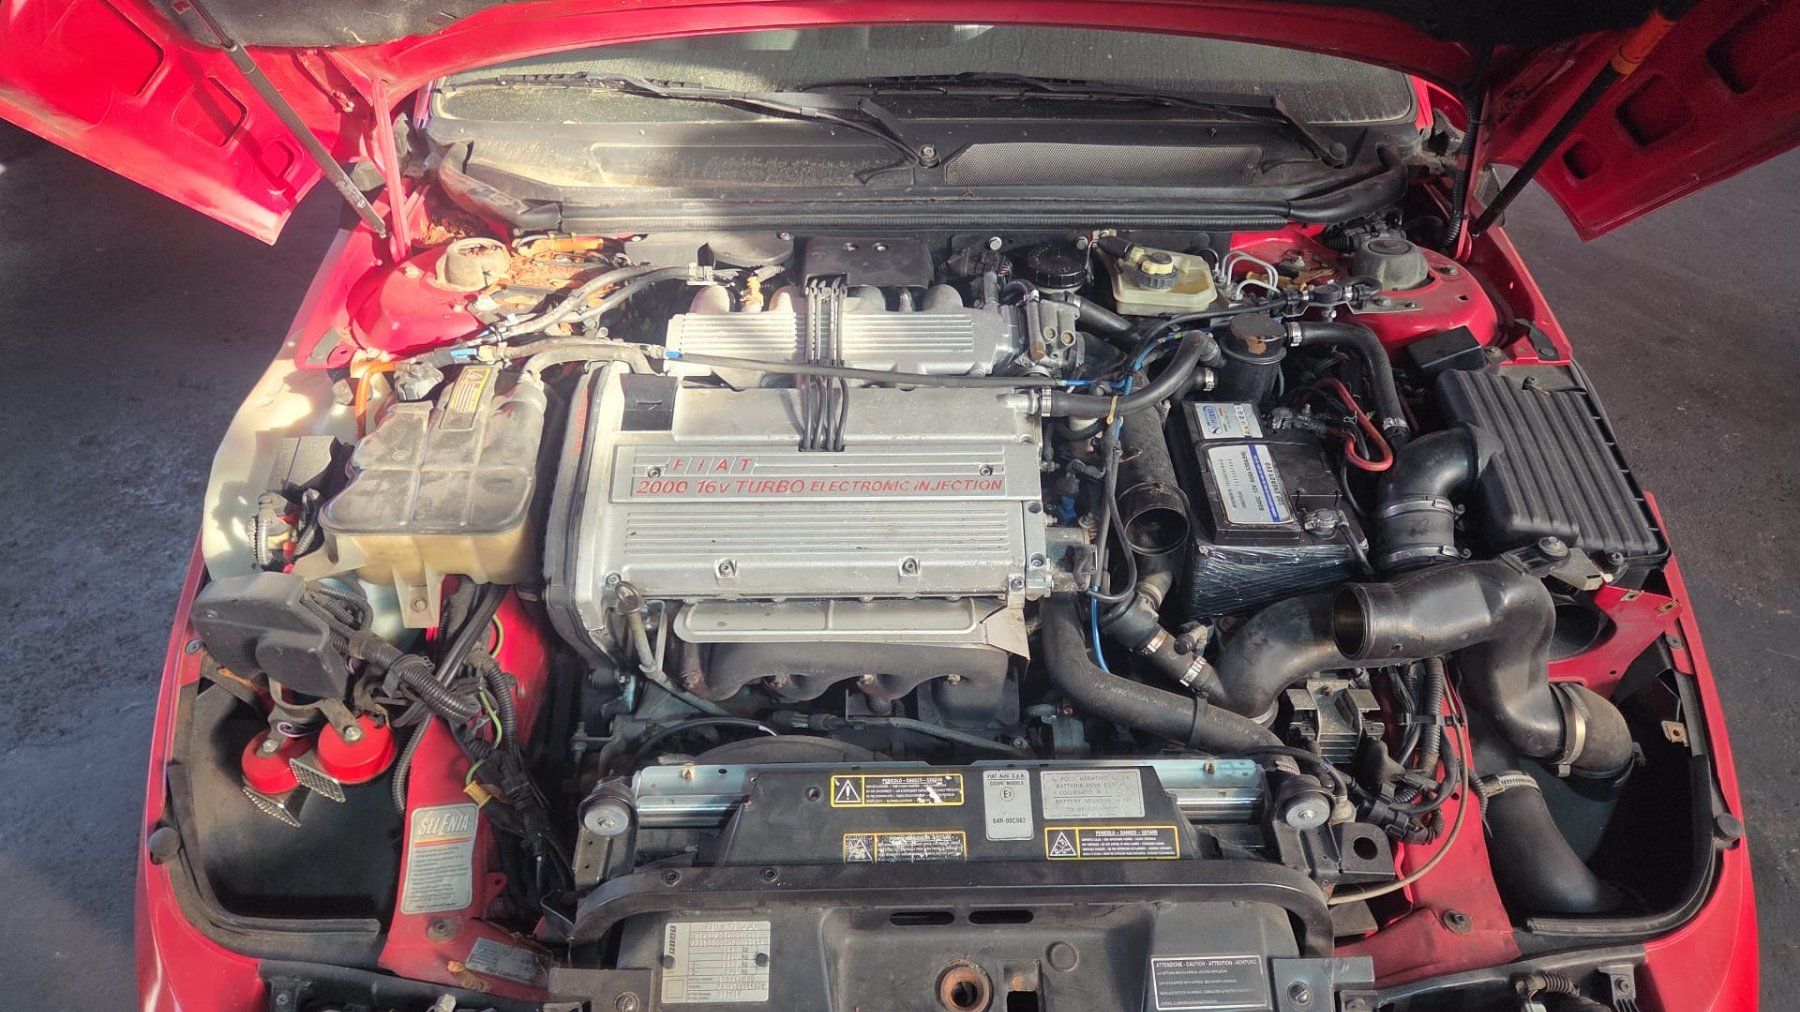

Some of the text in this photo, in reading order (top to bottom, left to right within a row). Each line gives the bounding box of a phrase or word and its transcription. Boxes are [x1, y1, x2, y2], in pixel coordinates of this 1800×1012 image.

[673, 459, 751, 471] FIAT
[636, 479, 688, 494] 2000
[735, 479, 804, 494] TURBO
[810, 480, 909, 492] ELECTRONIC
[914, 479, 1002, 491] INJECTION
[419, 813, 471, 836] SELENIA
